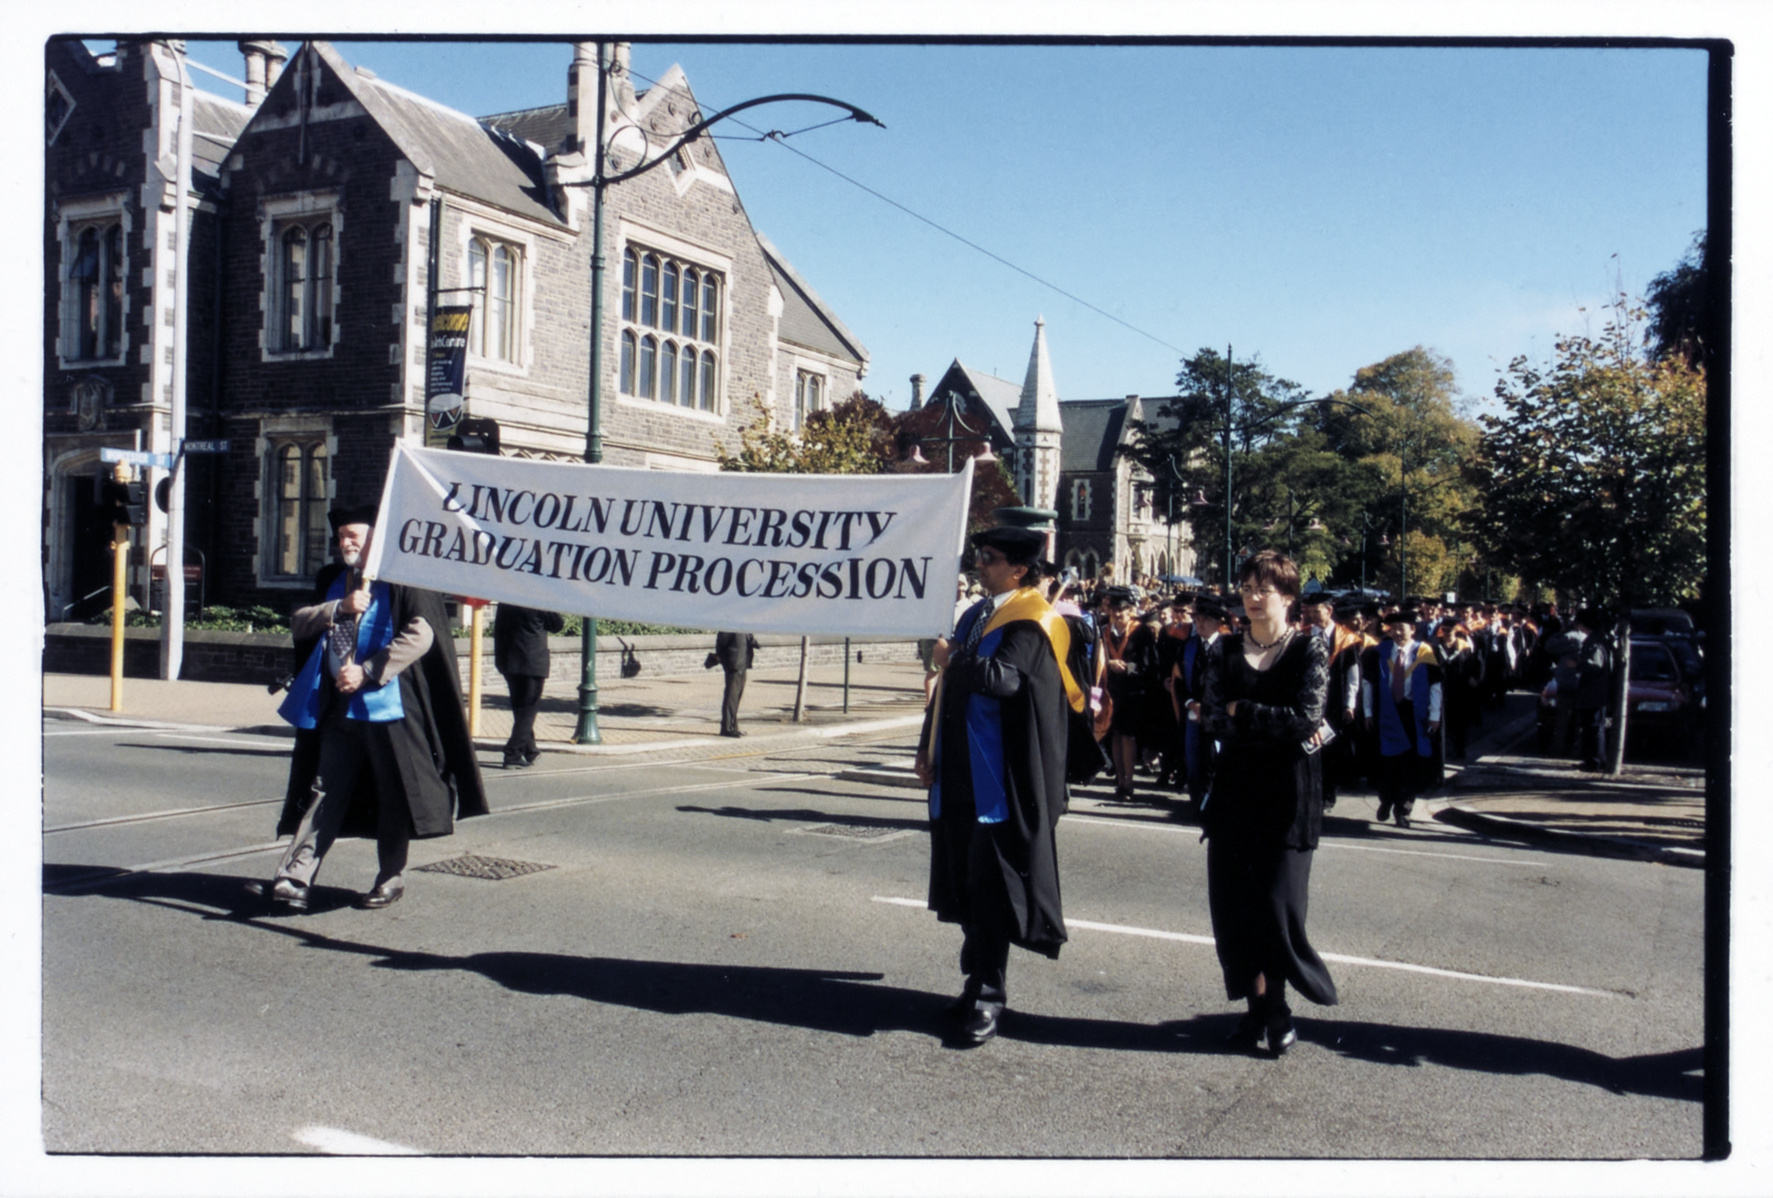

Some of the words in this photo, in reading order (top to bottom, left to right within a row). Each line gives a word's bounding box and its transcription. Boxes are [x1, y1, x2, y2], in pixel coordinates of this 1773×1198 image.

[442, 482, 616, 535] LINCOLN
[619, 499, 898, 551] UNIVERSITY
[399, 518, 640, 587] GRADUATION
[643, 551, 933, 600] PROCESSION
